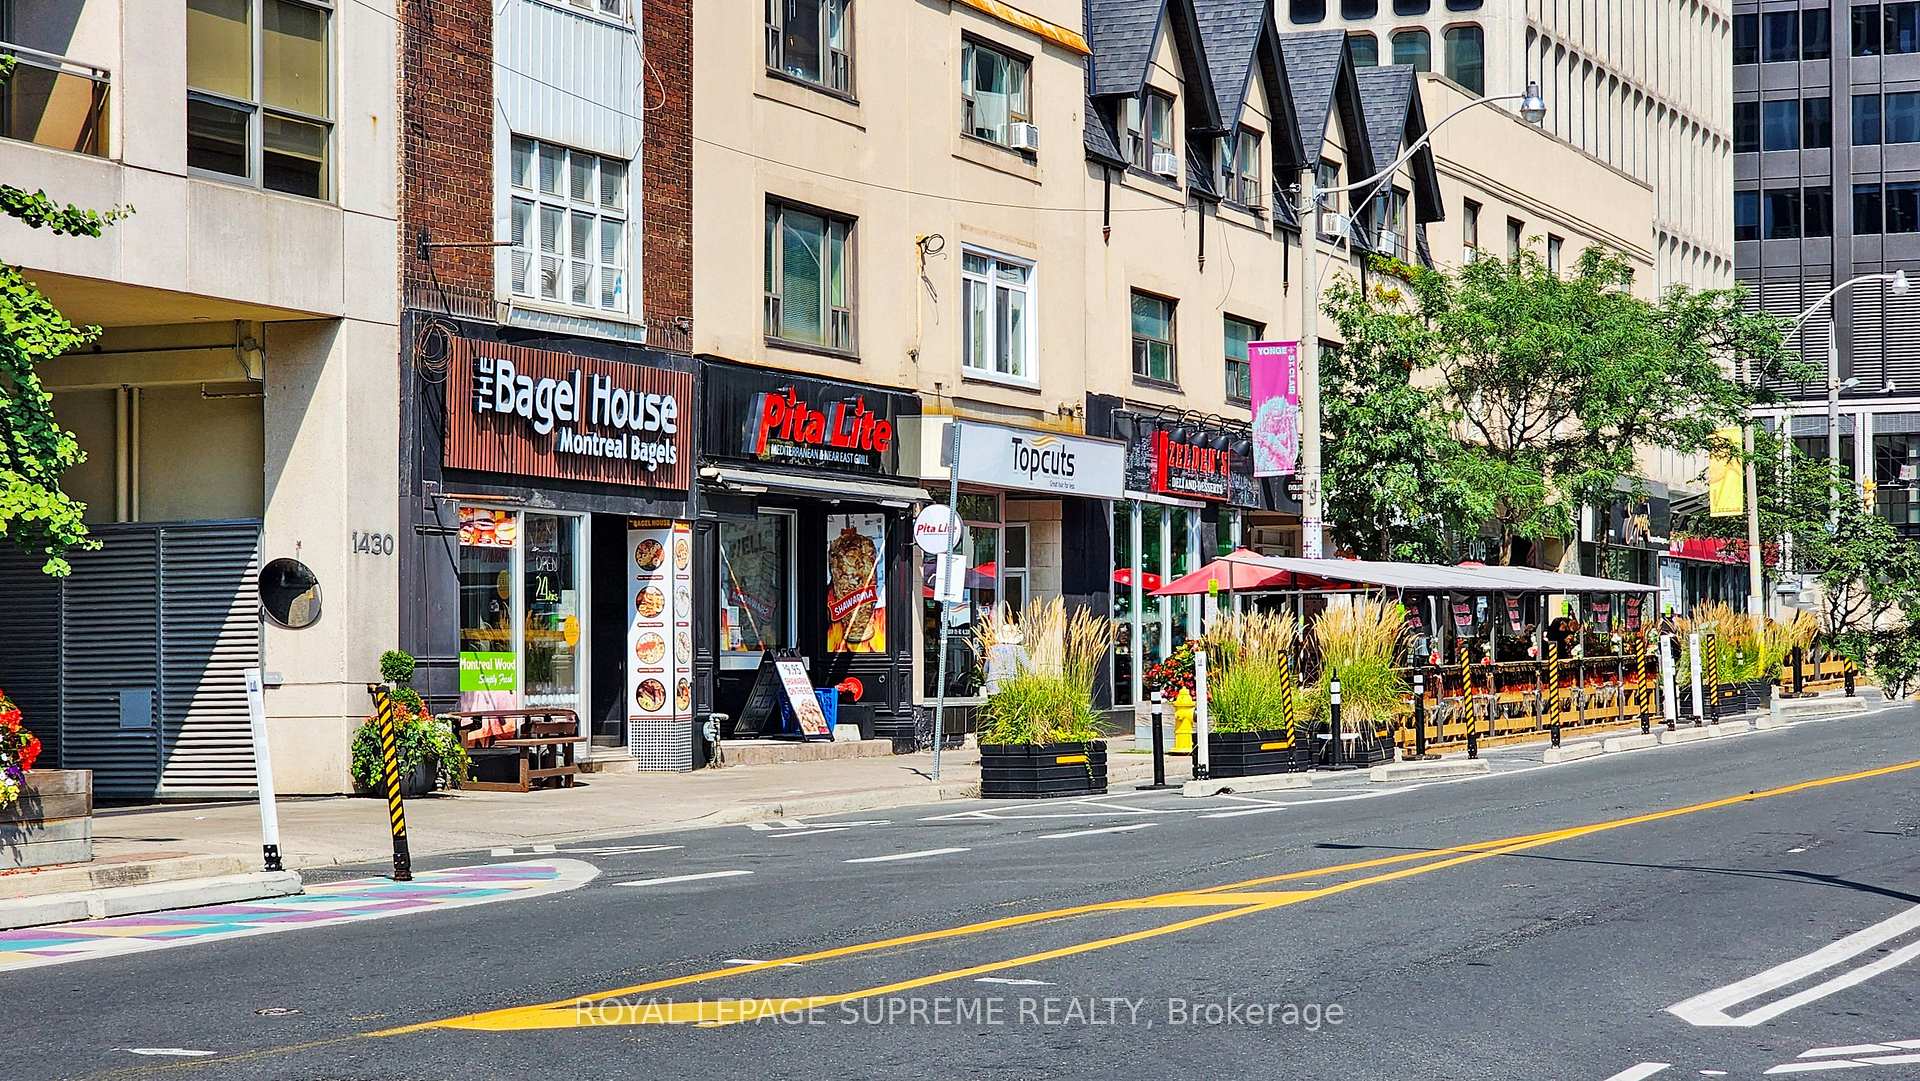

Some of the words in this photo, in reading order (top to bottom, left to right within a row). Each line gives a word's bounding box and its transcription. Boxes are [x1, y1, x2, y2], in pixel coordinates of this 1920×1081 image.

[1257, 346, 1288, 356] YONGE
[478, 357, 494, 413] THE
[495, 358, 580, 435] Bagel
[592, 372, 678, 434] House
[756, 385, 826, 457] Pita
[831, 395, 893, 453] Lite
[560, 427, 628, 460] Montreal
[630, 436, 677, 472] Bagels
[770, 444, 819, 459] MEDITERRANEAN
[824, 450, 840, 462] NEAR
[840, 452, 854, 464] EAST
[1012, 437, 1075, 480] Topcuts
[1169, 441, 1229, 477] ZELDEN'S
[1171, 477, 1185, 489] DELI
[916, 523, 936, 536] Pita
[352, 531, 394, 556] 1430
[535, 554, 558, 572] OPEN
[834, 589, 874, 616] SHAWARMA
[460, 656, 493, 670] Montreal
[494, 657, 516, 670] Wood
